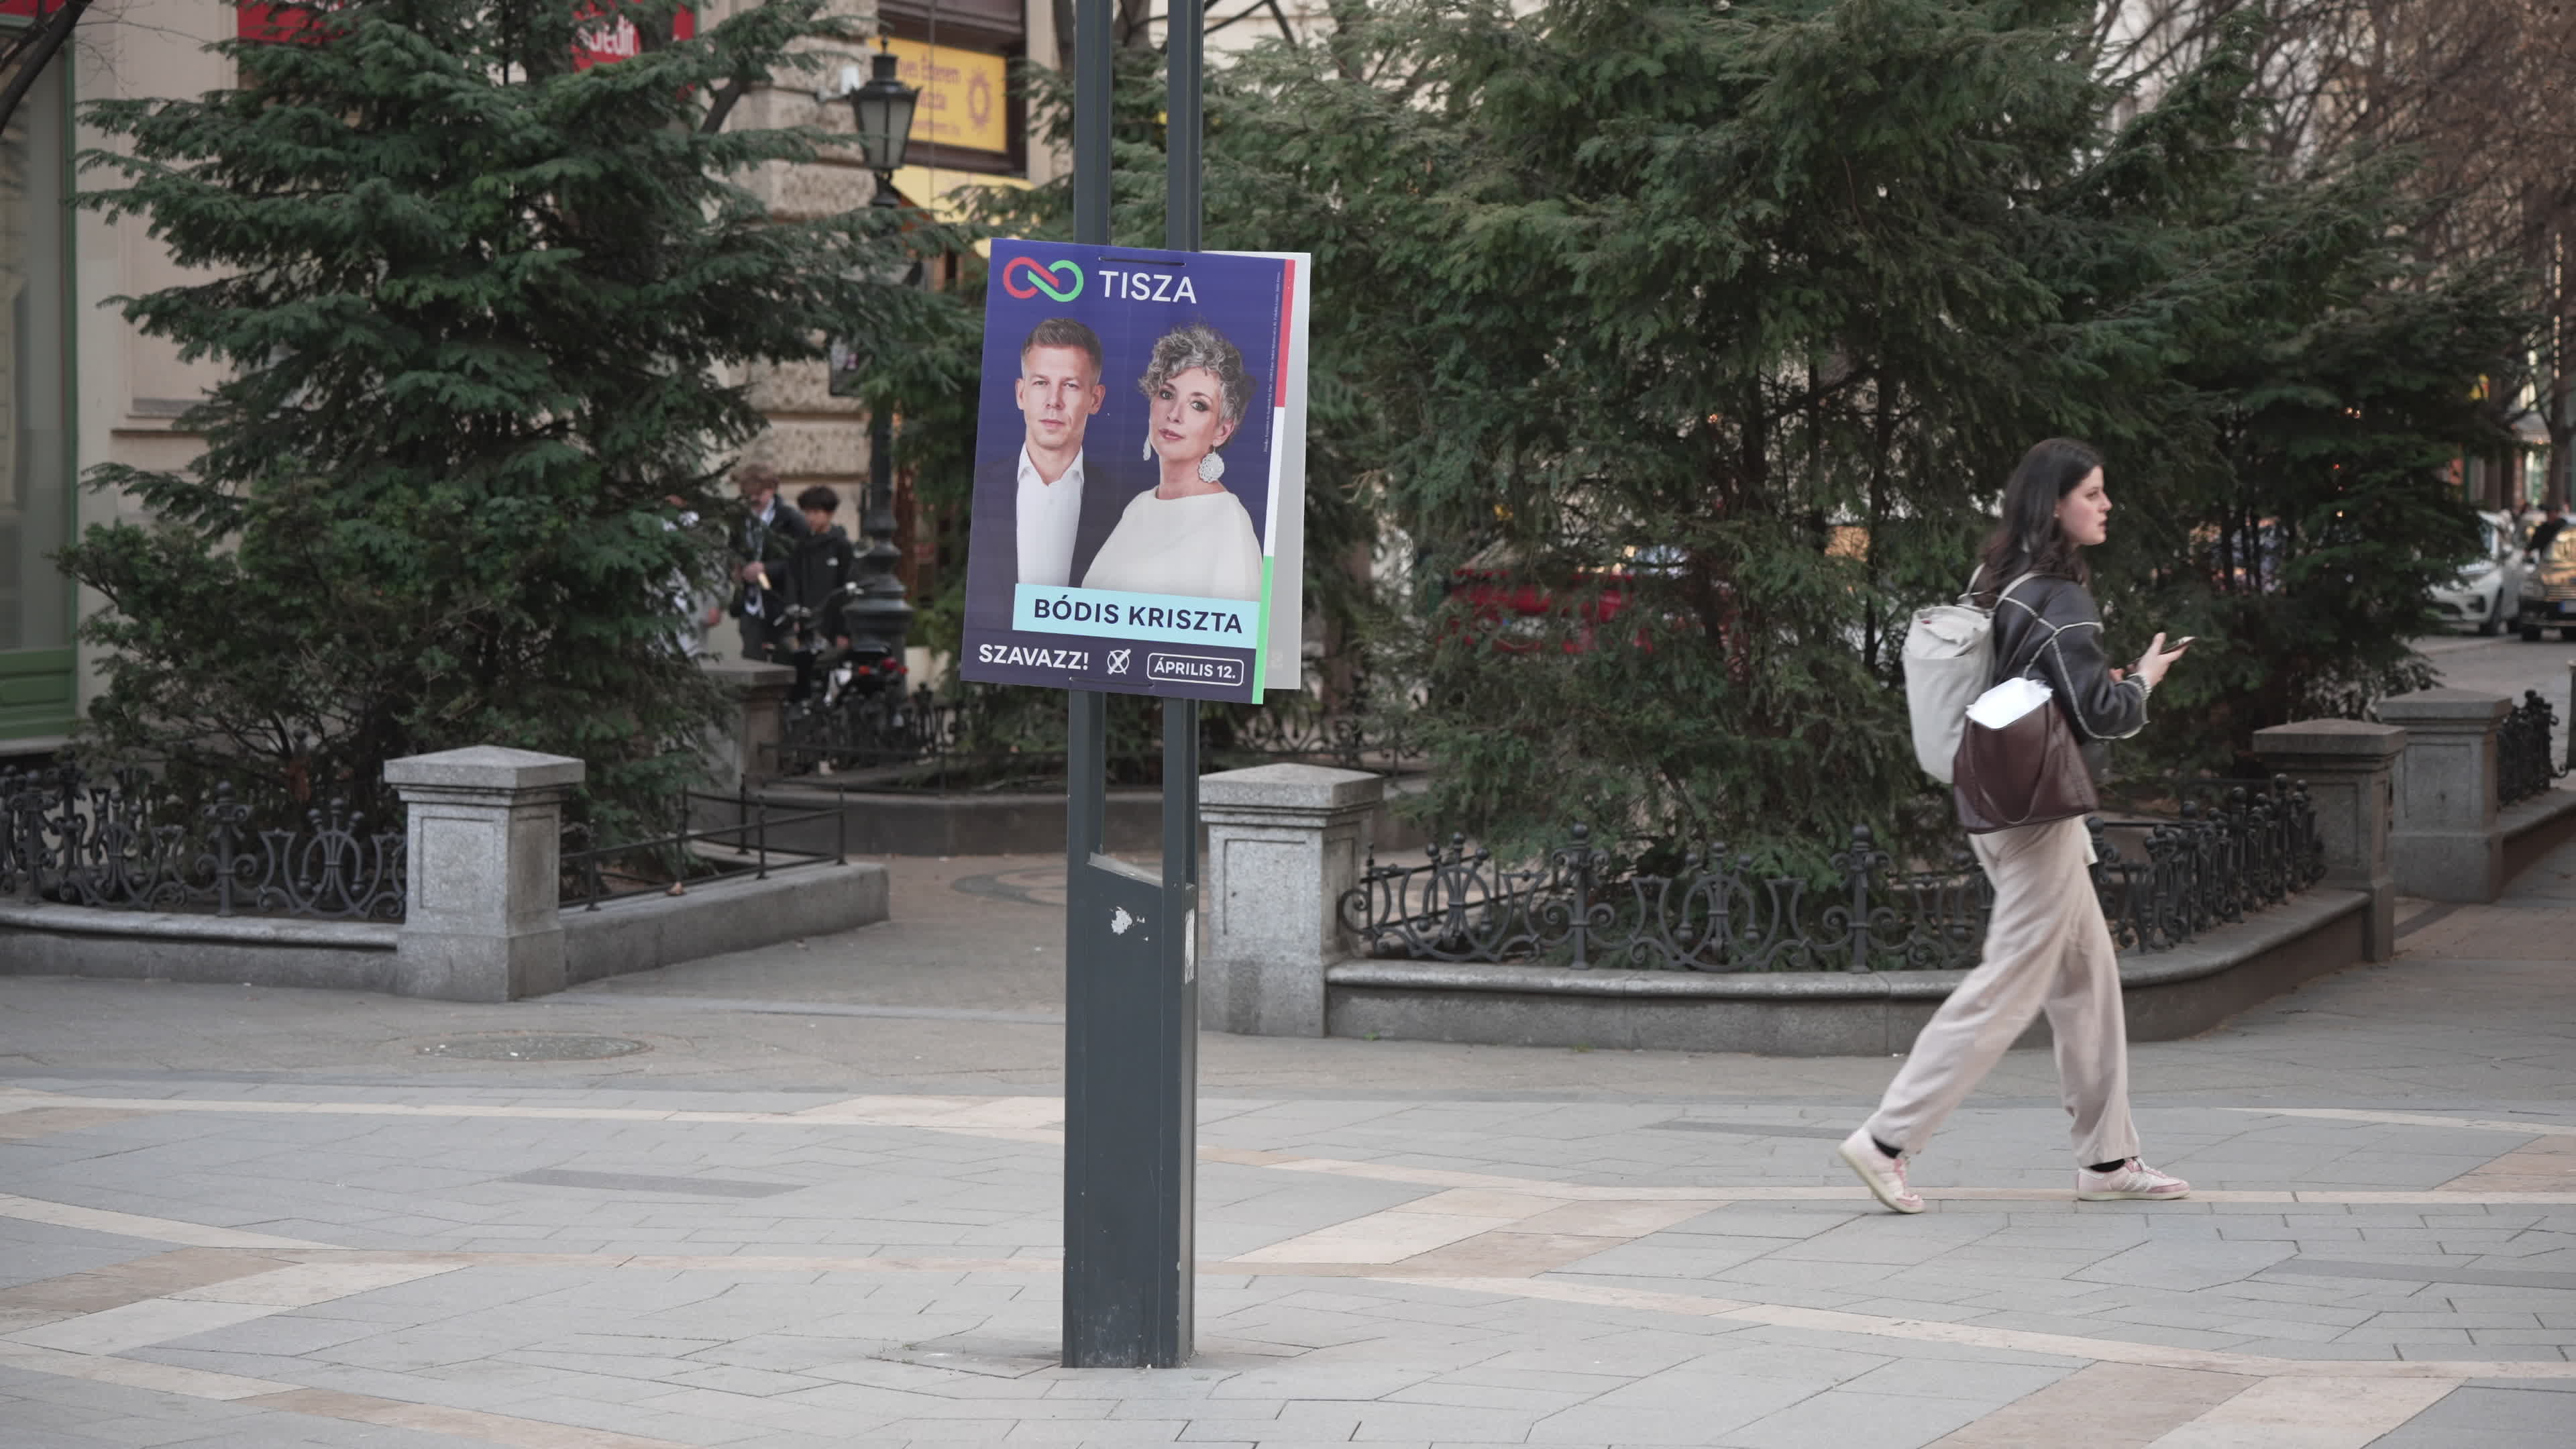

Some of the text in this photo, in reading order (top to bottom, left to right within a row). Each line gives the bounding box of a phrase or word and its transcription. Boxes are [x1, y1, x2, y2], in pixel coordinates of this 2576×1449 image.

[1098, 270, 1197, 304] TISZA
[1034, 594, 1242, 634] BÓDIS KRISZTA
[979, 643, 1089, 671] SZAVAZZ!
[1154, 657, 1236, 679] ÁPRILIS 12.
